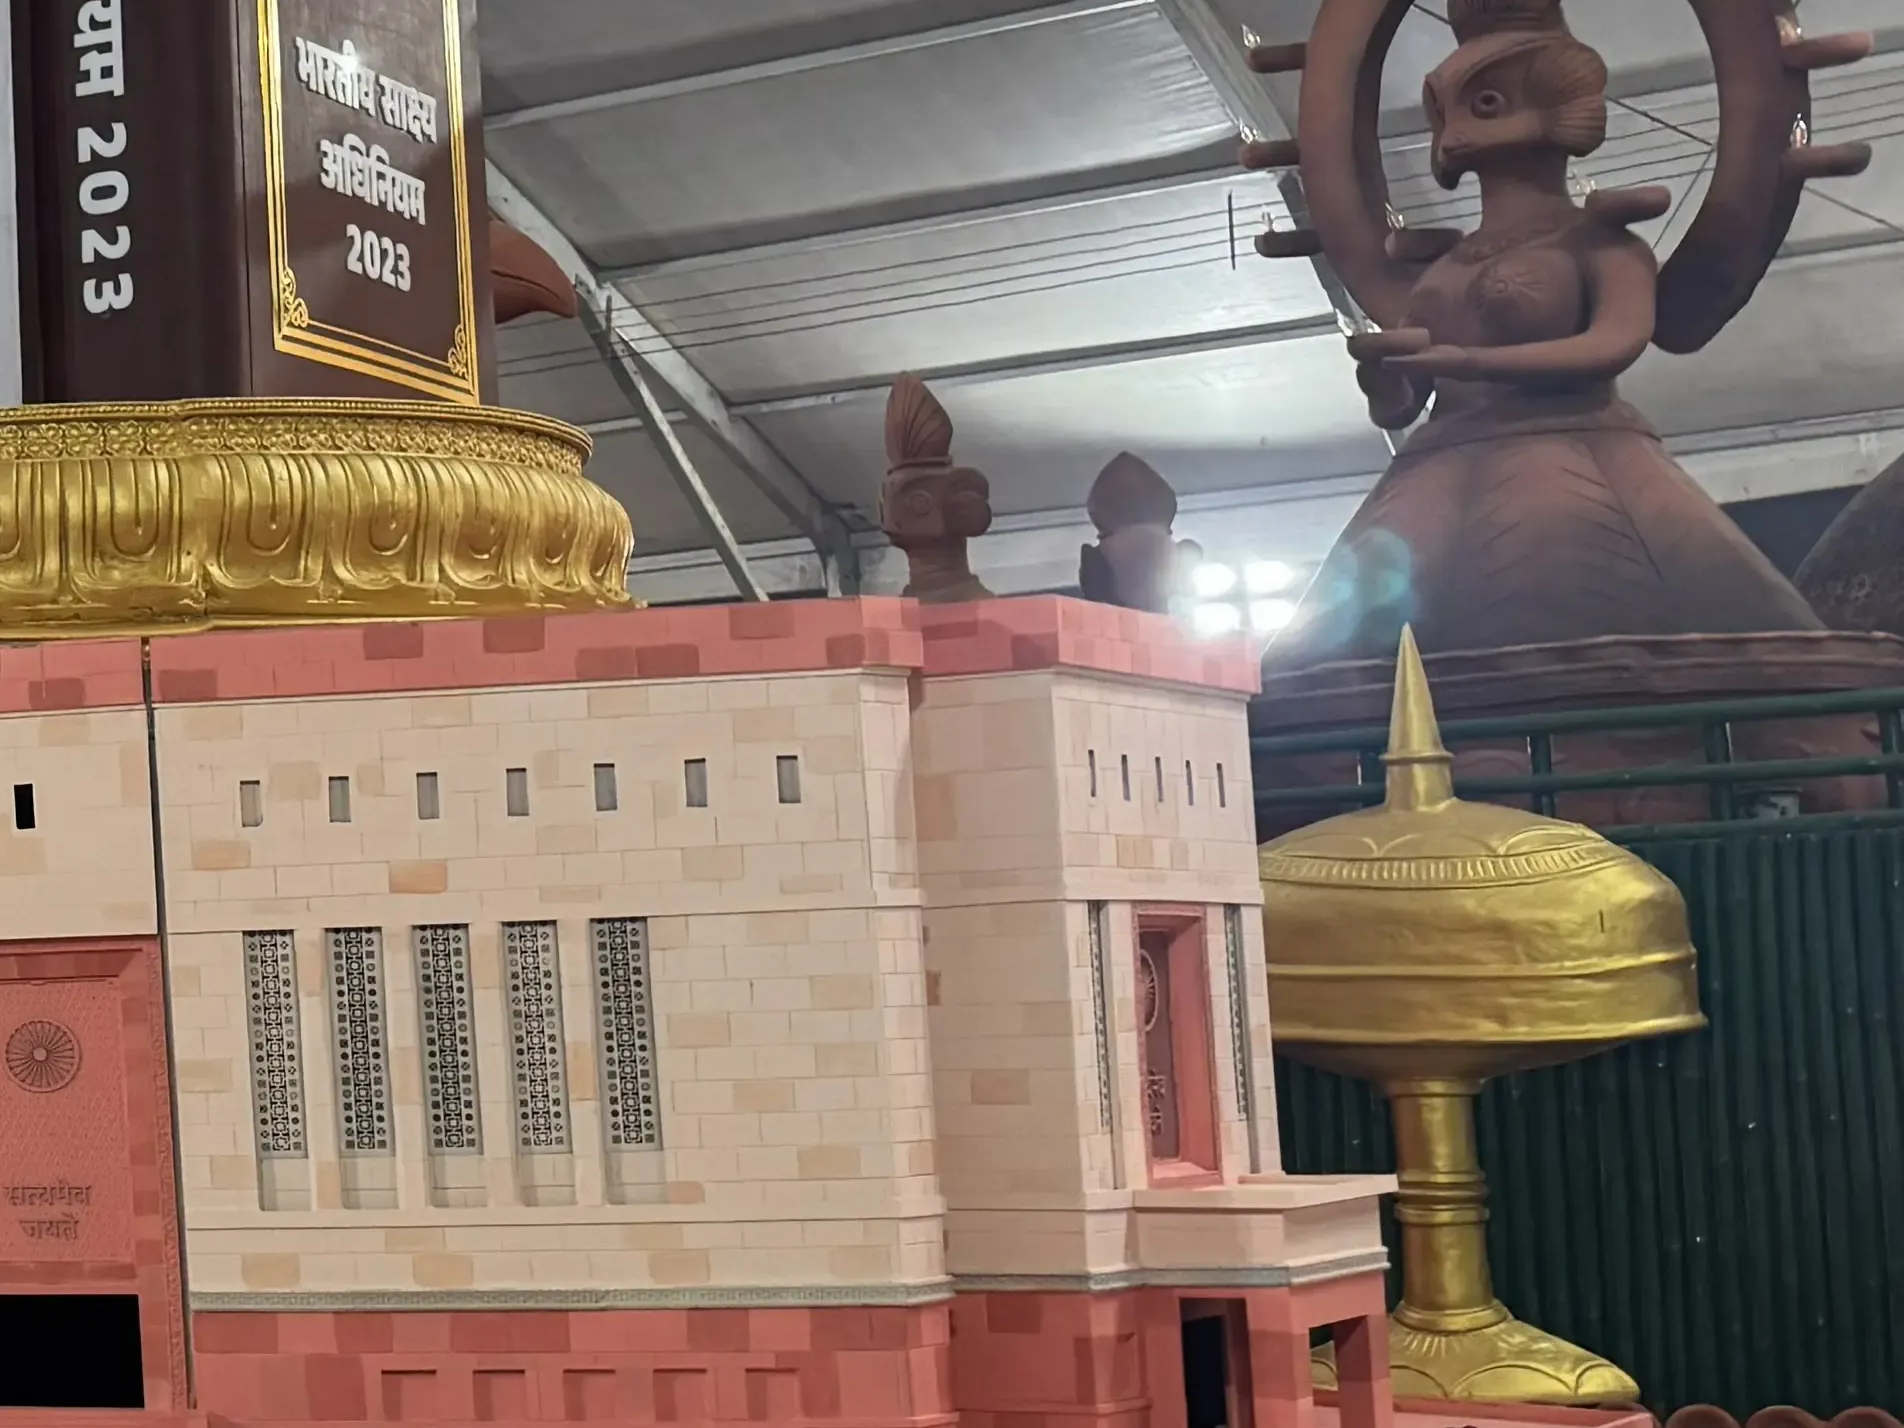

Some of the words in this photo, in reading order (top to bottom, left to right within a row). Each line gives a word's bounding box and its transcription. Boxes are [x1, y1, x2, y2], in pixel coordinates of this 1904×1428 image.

[296, 36, 376, 118] भारतीय
[379, 74, 438, 145] साक्ष्य
[76, 123, 134, 315] 2023
[319, 132, 427, 226] अधिनियम
[346, 223, 412, 293] 2023
